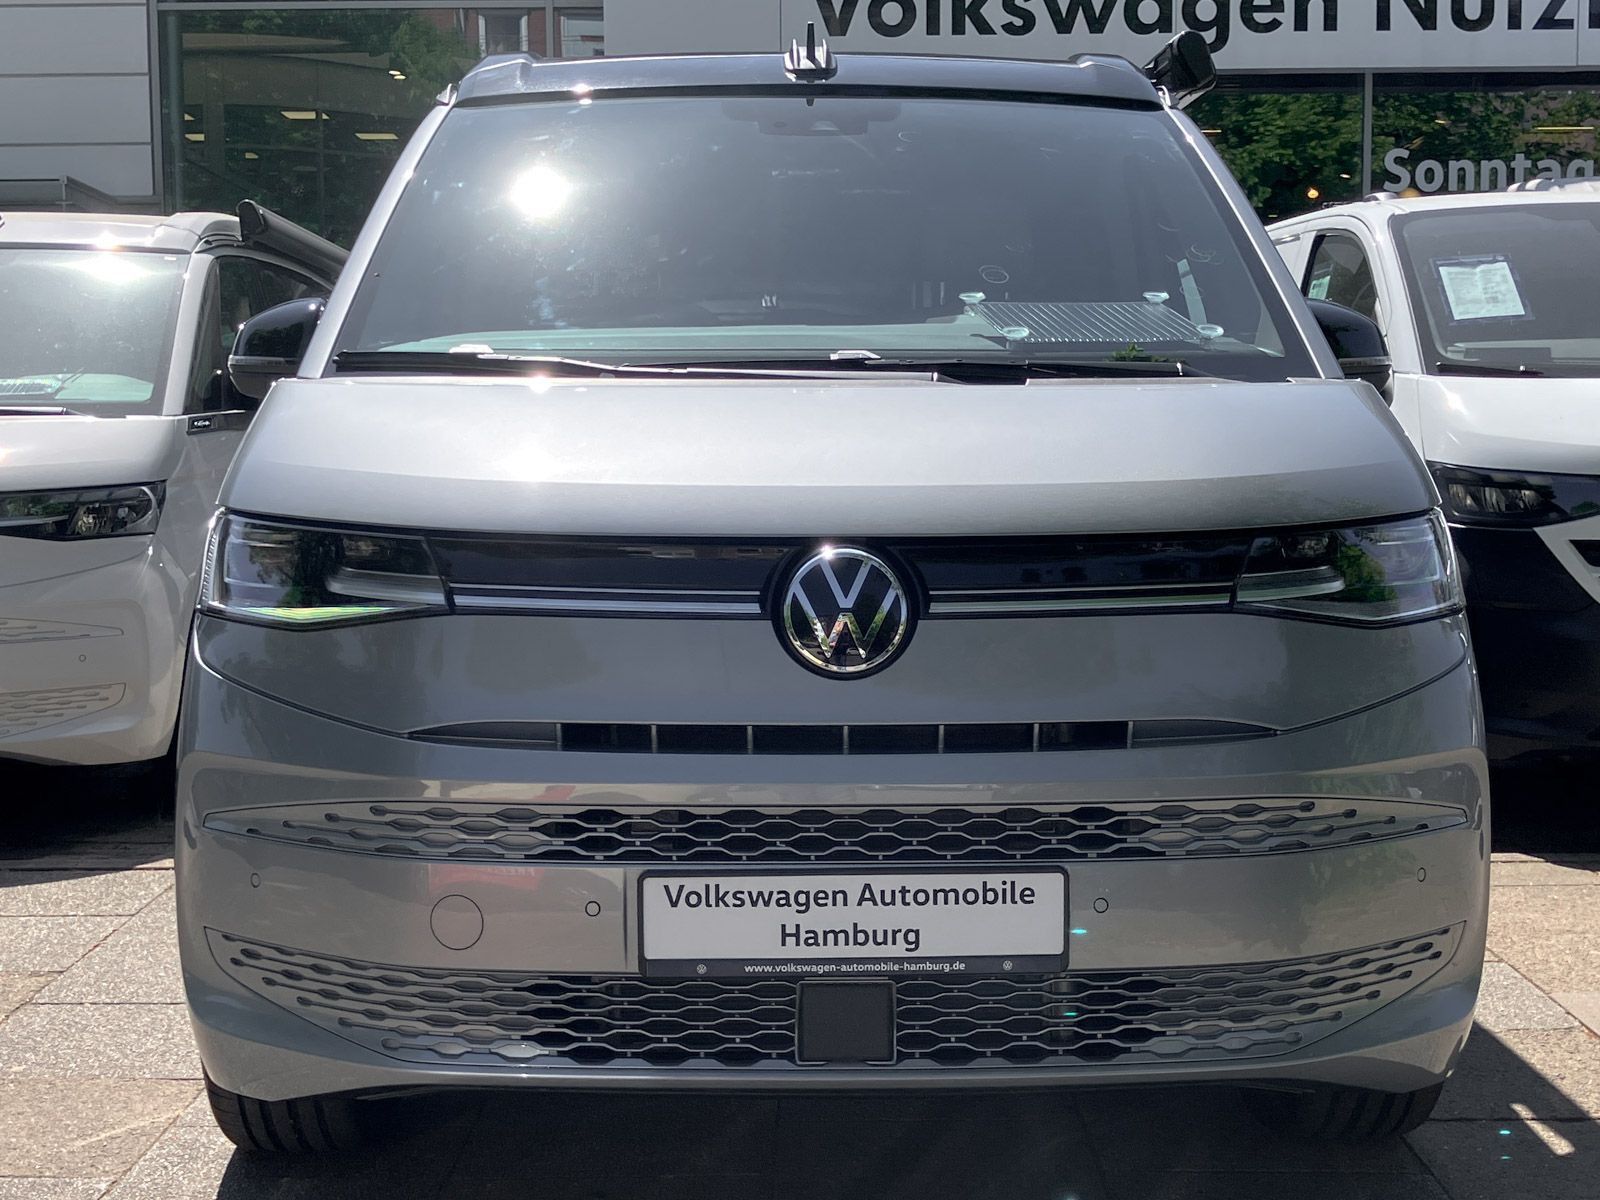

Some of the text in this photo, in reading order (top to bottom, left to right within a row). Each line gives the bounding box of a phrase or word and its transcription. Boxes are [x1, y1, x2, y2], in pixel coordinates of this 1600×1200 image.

[815, 0, 1338, 53] Volkswagen
[787, 550, 904, 670] VW
[663, 880, 1036, 914] Volkswagen Automobile
[780, 922, 921, 952] Hamburg
[744, 961, 966, 974] www.volkswagen-automobile-hamburg.de
